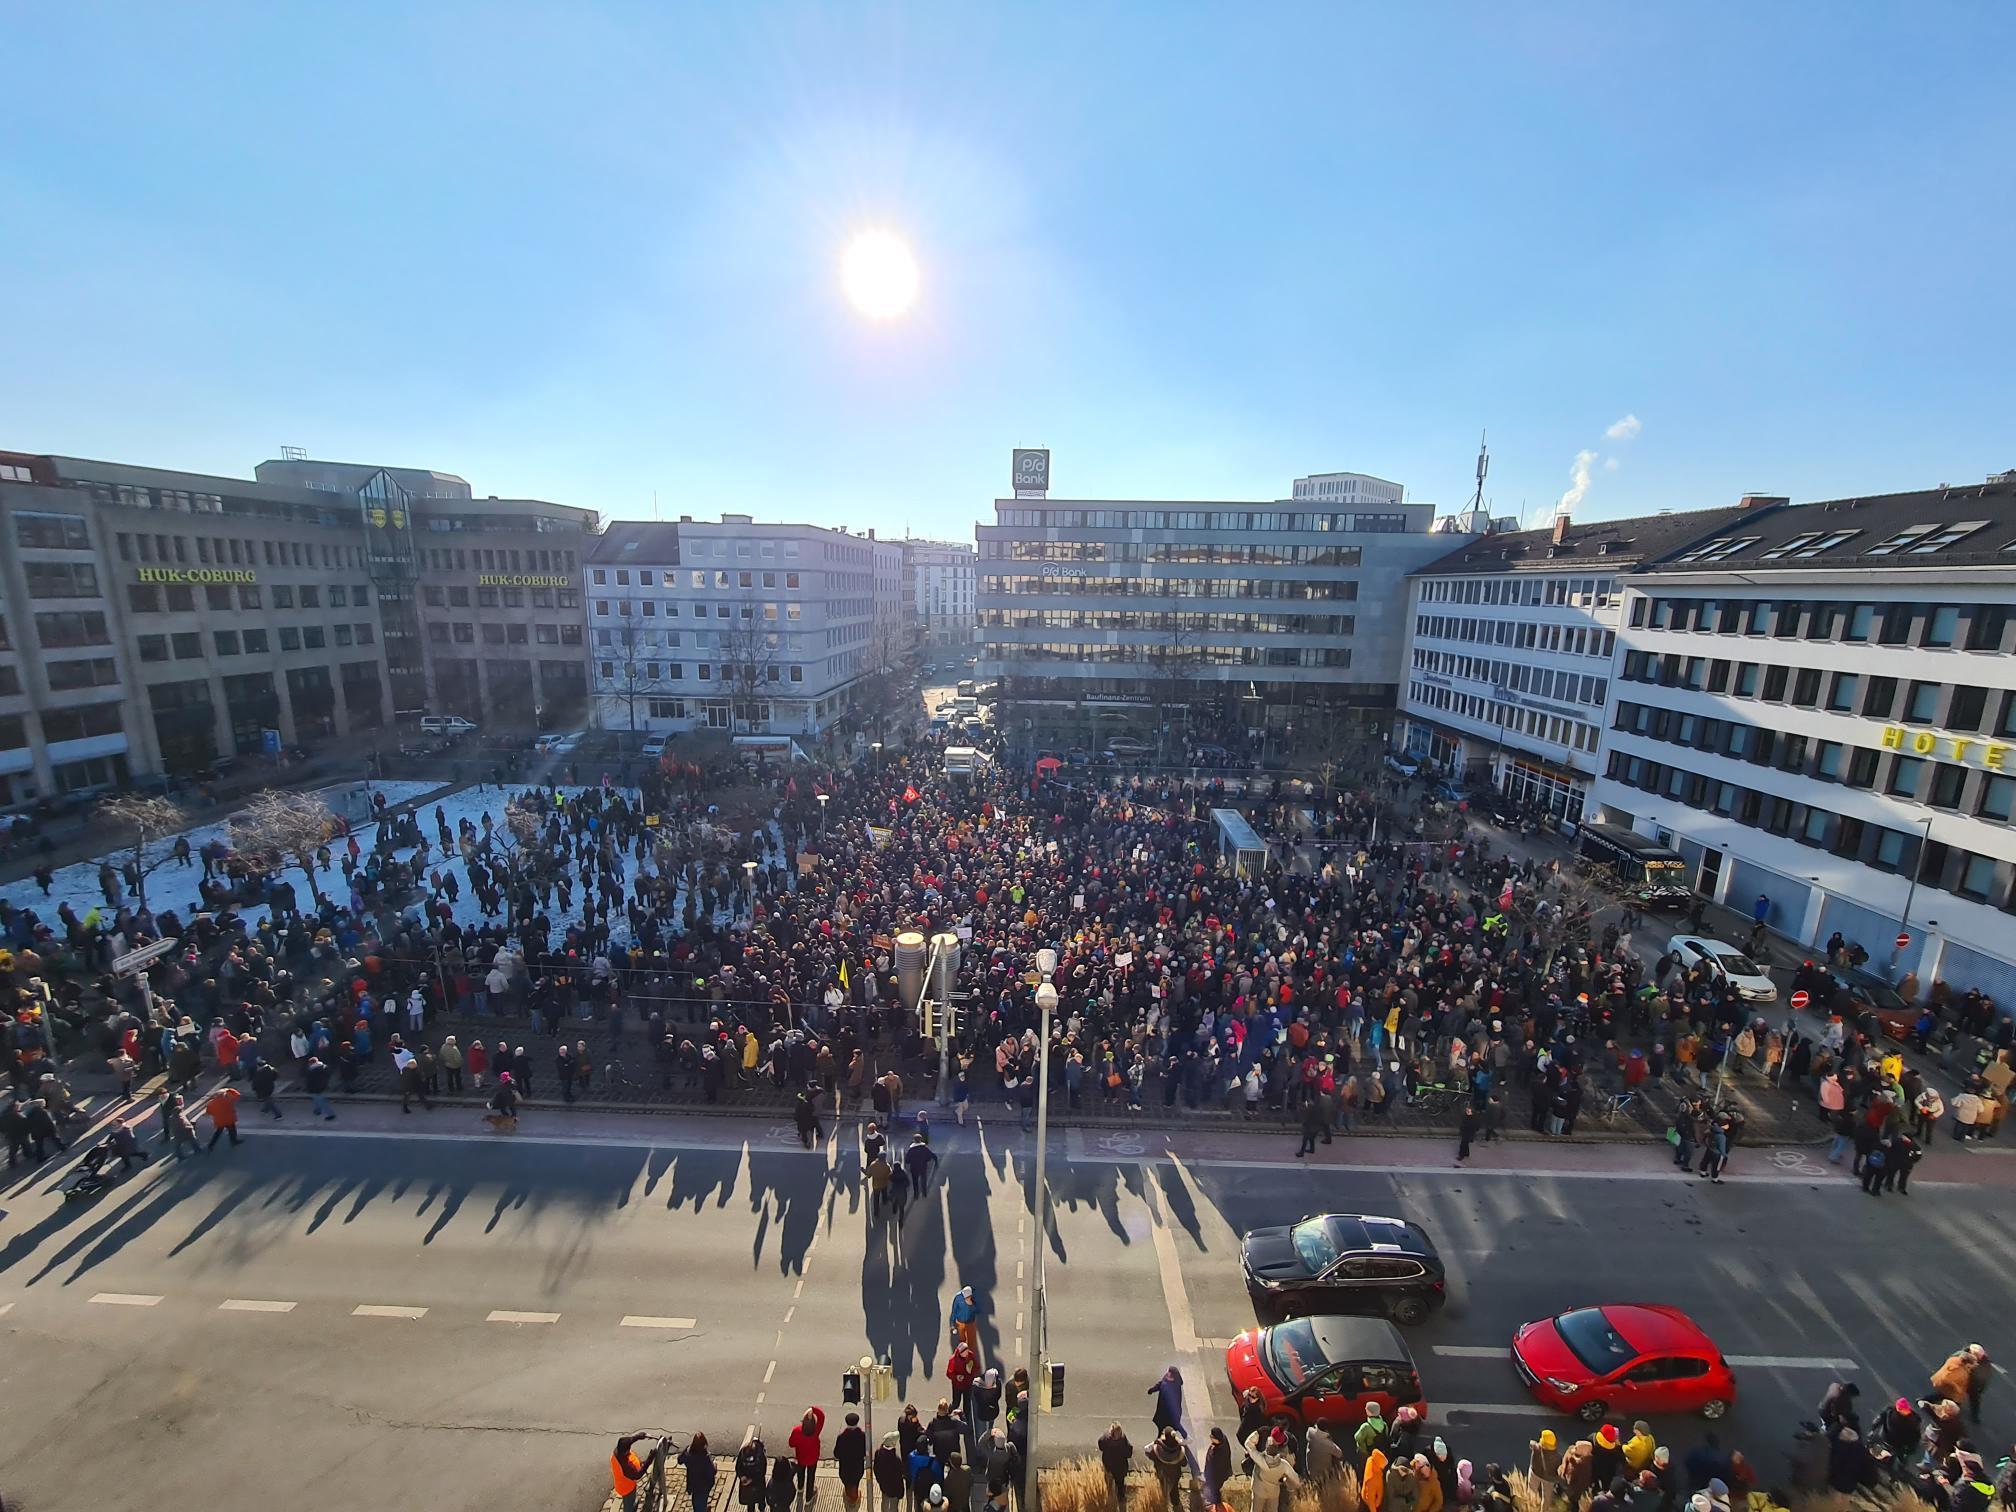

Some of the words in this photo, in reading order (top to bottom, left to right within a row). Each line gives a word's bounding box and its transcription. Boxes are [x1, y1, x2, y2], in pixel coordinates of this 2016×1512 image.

[1015, 472, 1046, 484] Bank
[138, 567, 257, 583] HUK-COBURG
[1061, 567, 1087, 577] Bank
[479, 574, 569, 586] HUK-COBURG
[1086, 693, 1152, 702] Baufinanz-Zentrum
[1881, 725, 2011, 769] HOTE
